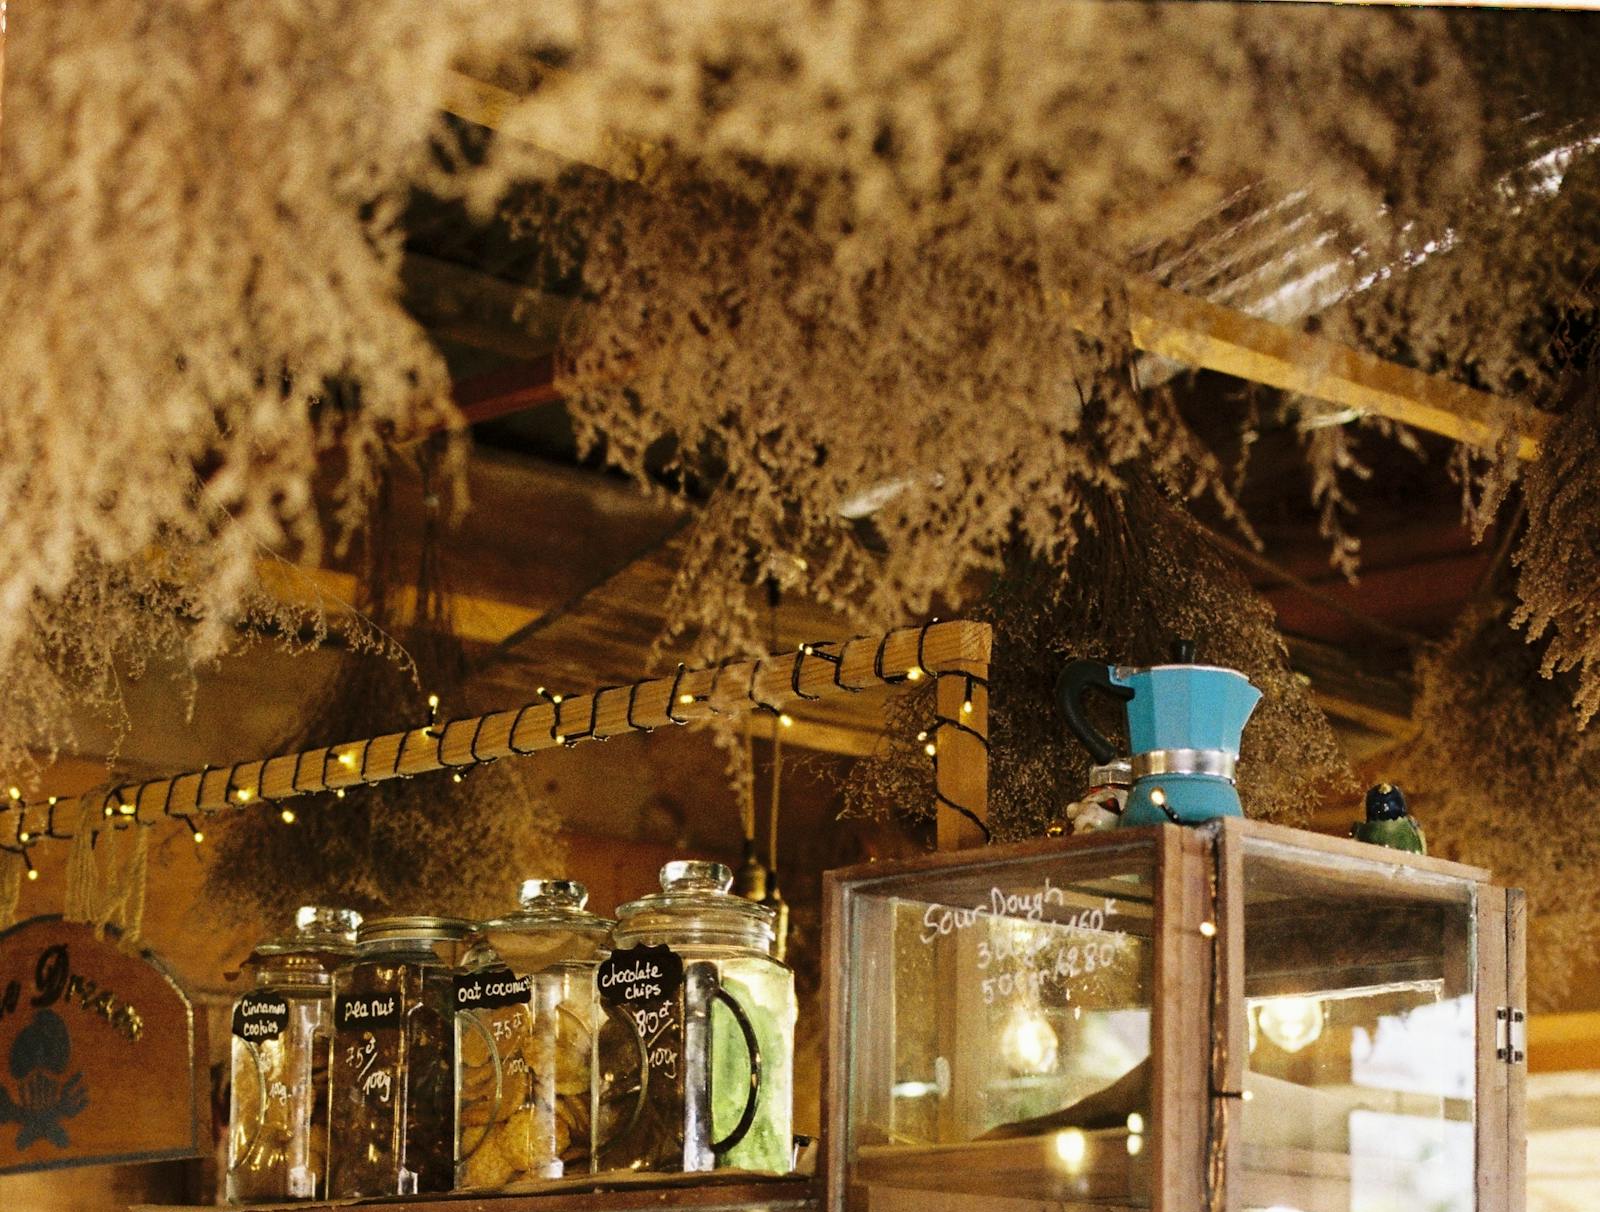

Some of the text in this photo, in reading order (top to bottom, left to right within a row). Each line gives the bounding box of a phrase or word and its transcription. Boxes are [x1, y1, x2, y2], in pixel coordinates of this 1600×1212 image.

[919, 878, 1063, 944] Sour Dough
[601, 960, 663, 988] chocolate
[624, 982, 663, 1001] chips
